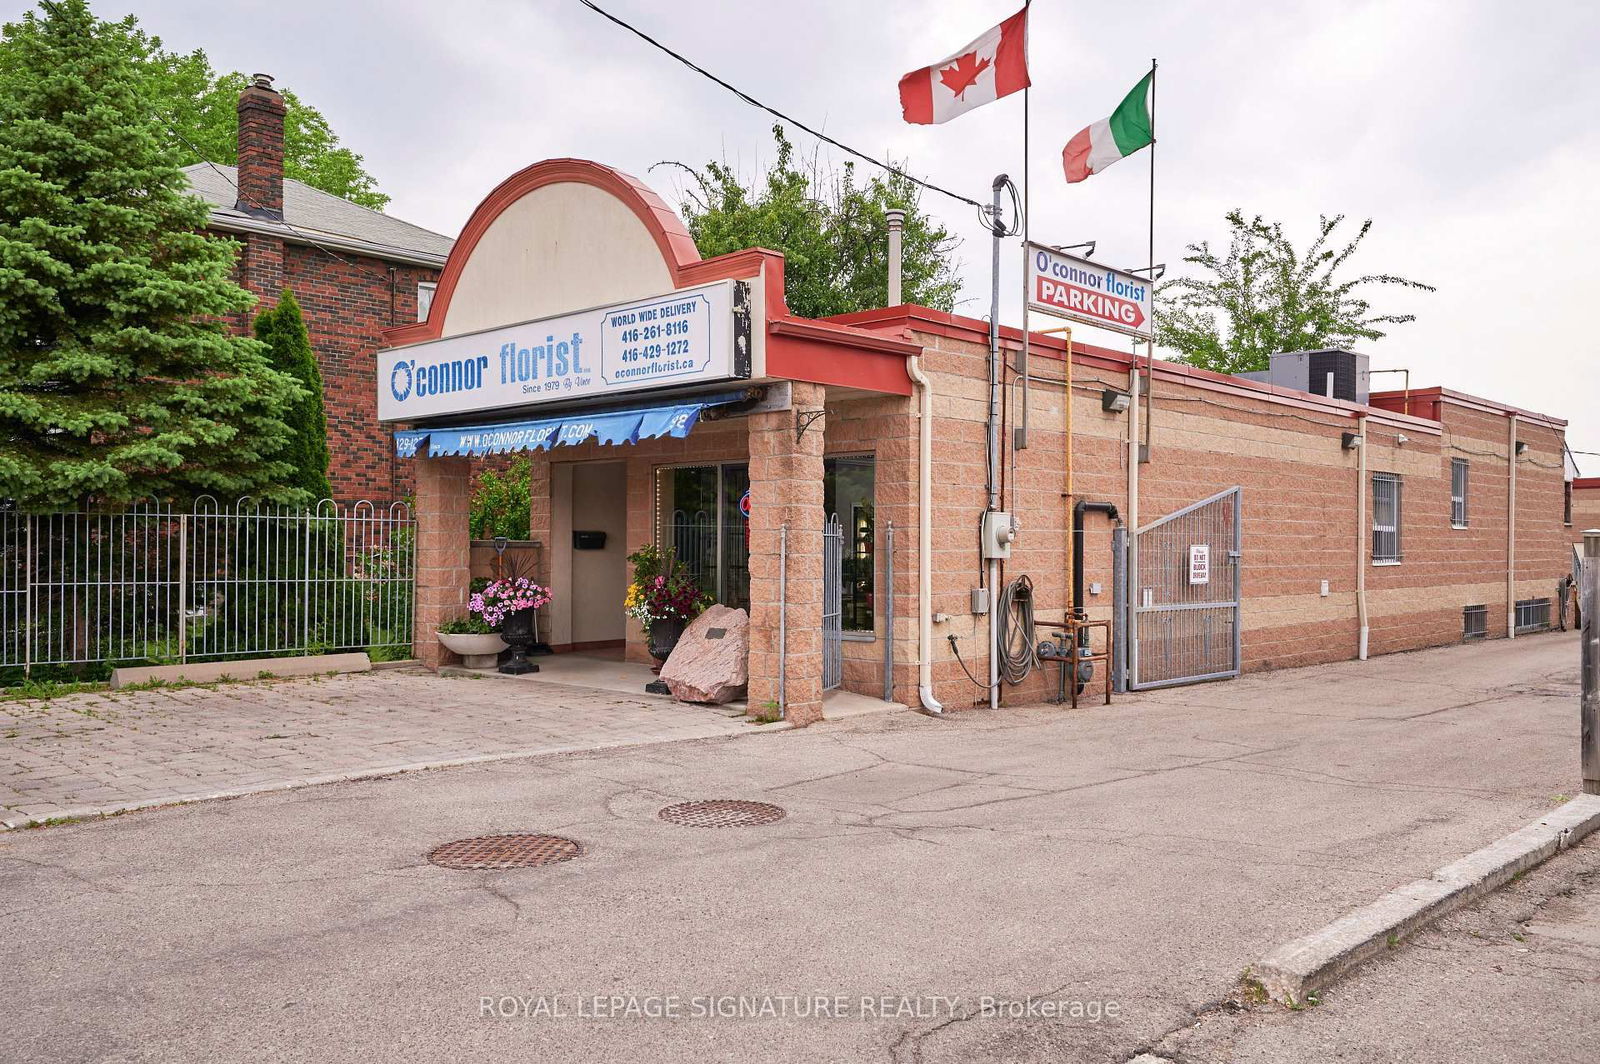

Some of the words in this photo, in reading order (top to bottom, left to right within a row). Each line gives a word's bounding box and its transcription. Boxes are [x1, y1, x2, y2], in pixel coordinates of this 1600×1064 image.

[1036, 251, 1103, 289] O'connor
[1106, 272, 1145, 302] florist
[1041, 280, 1136, 323] PARKING
[611, 313, 636, 328] WORLD
[639, 309, 658, 322] WIDE
[660, 301, 697, 318] DELIVERY
[621, 319, 689, 343] 416-261-8116
[500, 332, 583, 385] florist
[621, 339, 689, 363] 416-429-1272
[615, 359, 694, 379] oconnorflorist.ca
[522, 384, 541, 394] Since
[544, 381, 560, 391] 1979
